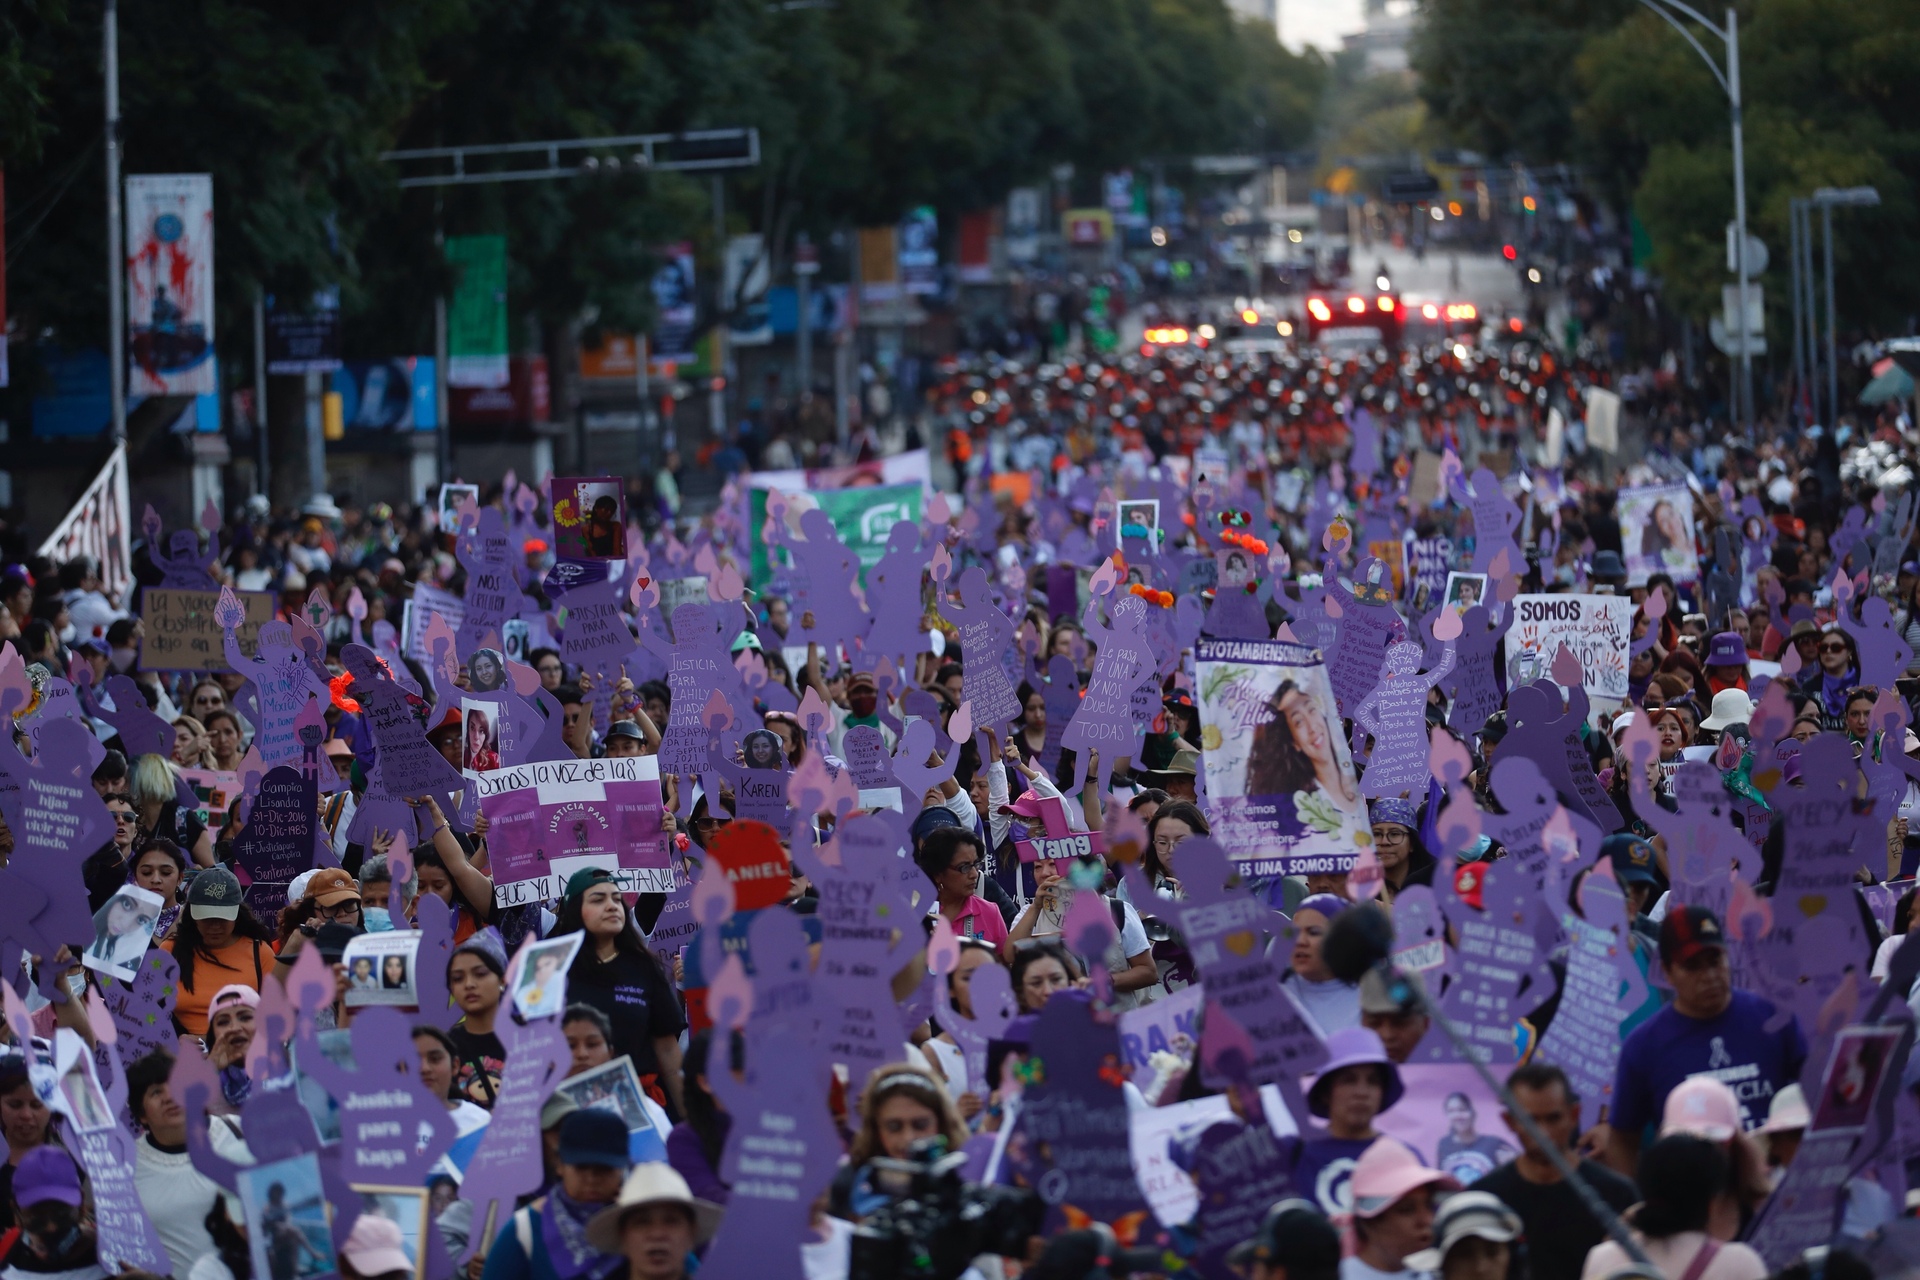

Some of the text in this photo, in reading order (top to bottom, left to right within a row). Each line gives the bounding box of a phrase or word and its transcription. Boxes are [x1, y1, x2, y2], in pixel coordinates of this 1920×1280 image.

[477, 575, 500, 591] NOS
[568, 603, 618, 622] #JUSTICIA
[1114, 597, 1146, 623] BRENDA
[1521, 600, 1581, 621] SOMOS
[582, 619, 608, 634] PARA
[965, 620, 989, 637] Brenda
[566, 632, 620, 655] ARIADNA
[1101, 636, 1137, 665] Le pasa
[1387, 642, 1423, 661] BRENDA
[669, 653, 718, 672] JUSTICIA
[1108, 661, 1130, 679] UNA
[1386, 655, 1413, 670] KATYA
[1393, 665, 1417, 677] LAYSA
[1102, 681, 1122, 699] NOS
[1377, 687, 1411, 698] nombres
[1390, 680, 1418, 690] Muchos
[671, 689, 710, 701] ZAHILY
[1411, 696, 1422, 706] de
[365, 698, 402, 721] Ingrid
[670, 702, 705, 716] GUADA
[1082, 696, 1116, 714] Duele
[670, 716, 701, 727] LUNA
[1405, 716, 1416, 727] de
[1077, 721, 1124, 741] TODAS
[1387, 731, 1418, 741] violencia
[400, 752, 431, 763] Puebla
[675, 755, 698, 763] 2021
[1400, 751, 1418, 761] vivas
[1567, 750, 1585, 760] FUE
[478, 766, 530, 795] Somos
[533, 763, 550, 785] la
[584, 761, 605, 783] de
[610, 758, 637, 781] las
[659, 763, 680, 774] ASTA
[849, 768, 877, 777] SESINADA
[1375, 760, 1423, 778] seguras nos
[28, 778, 84, 799] Nuestras
[262, 780, 302, 796] Campira
[741, 777, 780, 798] KAREN
[39, 794, 69, 810] hijas
[260, 795, 300, 808] Lisandra
[636, 803, 657, 812] MENOS!
[1231, 804, 1276, 815] Amamos
[24, 807, 80, 825] merecen
[253, 810, 307, 823] 31-Dic-2016
[502, 814, 513, 824] UNA
[549, 802, 609, 834] JUSTICIA PARA
[25, 821, 75, 838] vivir sin
[254, 824, 308, 837] 10-Dic-1985
[1236, 819, 1279, 831] siempre
[27, 835, 69, 850] miedo.
[1031, 835, 1091, 860] Yang
[272, 852, 301, 861] Campira
[255, 864, 296, 880] Sentencia
[726, 862, 788, 882] ANIEL
[1239, 856, 1360, 876] ES UNA, SOMOS TOD
[902, 870, 919, 881] QUE
[664, 899, 690, 914] años
[344, 1089, 413, 1111] Justicia
[358, 1121, 401, 1142] para
